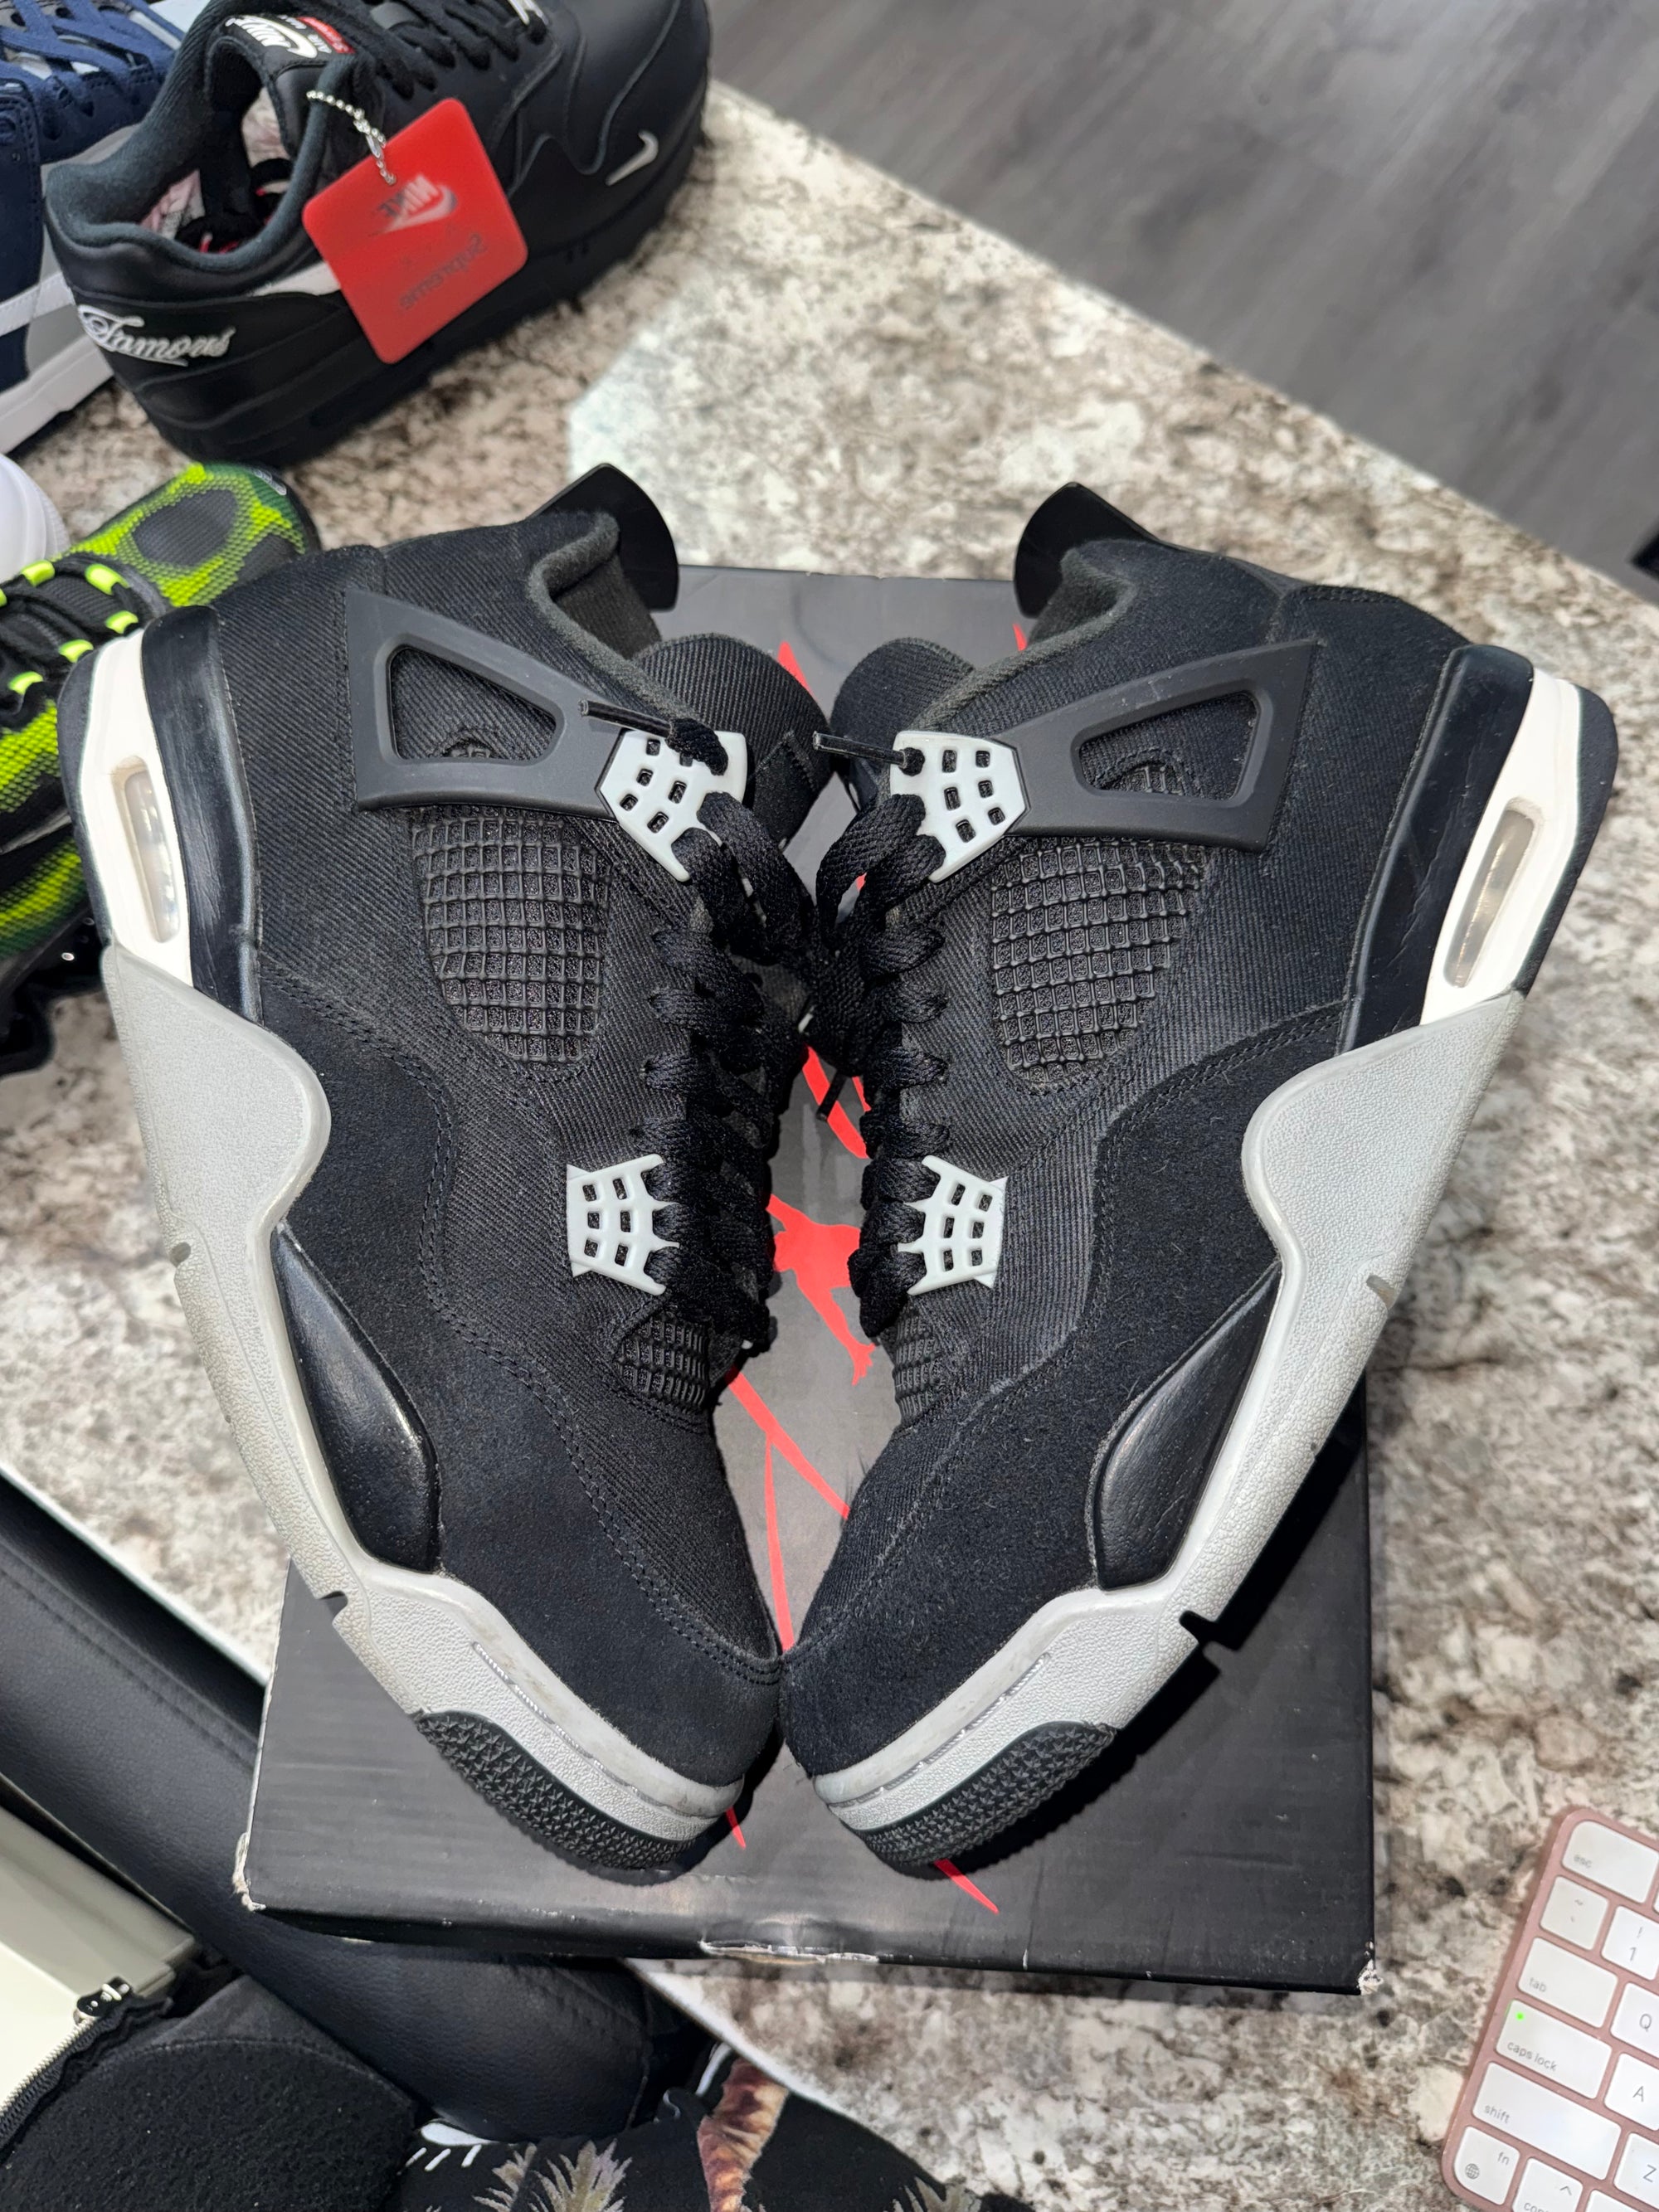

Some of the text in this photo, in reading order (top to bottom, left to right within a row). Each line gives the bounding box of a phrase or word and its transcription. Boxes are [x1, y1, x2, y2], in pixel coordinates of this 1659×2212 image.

[77, 304, 236, 367] Famous
[1574, 1854, 1592, 1869] esc
[1629, 1947, 1637, 1962] 1
[1528, 1977, 1547, 1993] tab
[1639, 2014, 1653, 2032] Q
[1507, 2041, 1558, 2072] caps lock
[1632, 2086, 1645, 2103] A
[1484, 2104, 1511, 2124] shift
[1497, 2151, 1510, 2166] fn
[1642, 2164, 1657, 2183] Z
